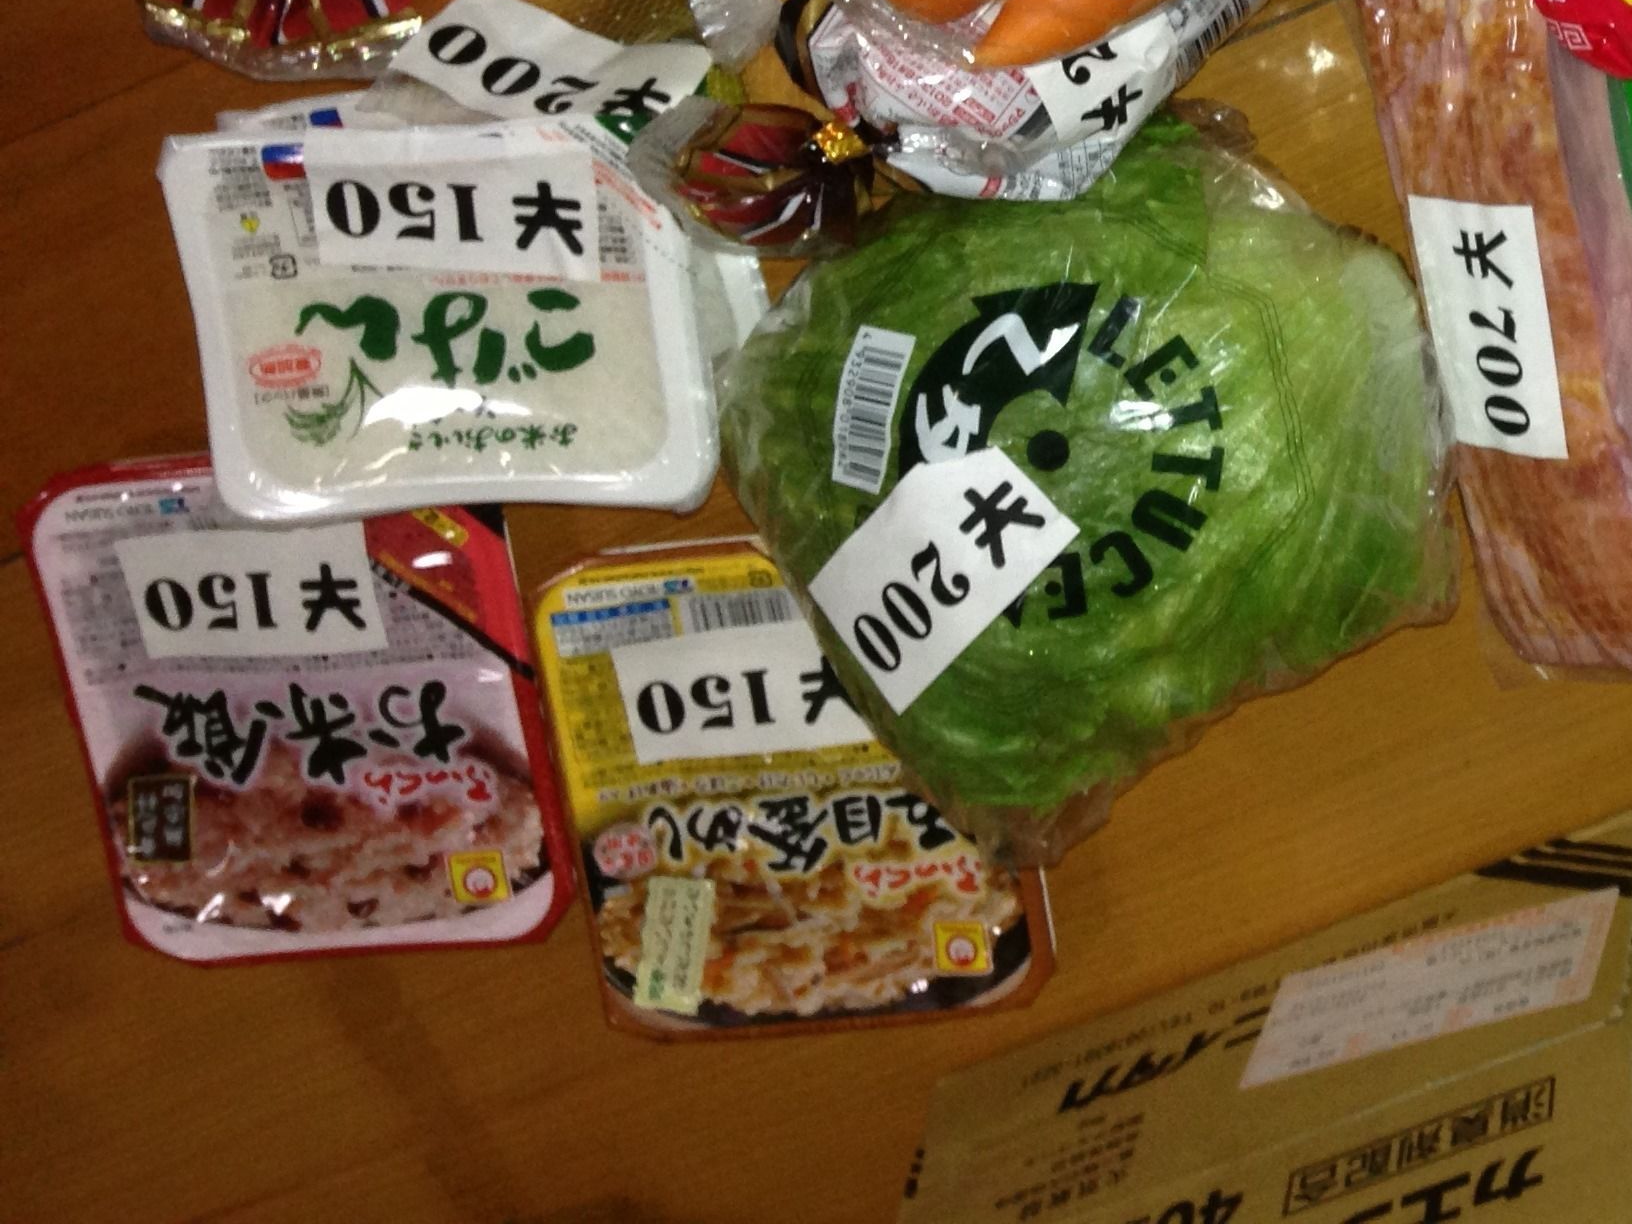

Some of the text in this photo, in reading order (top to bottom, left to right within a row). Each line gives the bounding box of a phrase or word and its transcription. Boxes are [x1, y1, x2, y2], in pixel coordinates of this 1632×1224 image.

[425, 23, 671, 120] ¥200
[1058, 39, 1142, 132] ¥2
[323, 178, 584, 256] ¥150
[294, 289, 595, 387] ごはん
[1452, 228, 1530, 436] ¥700
[142, 562, 366, 632] ¥150
[852, 479, 1046, 673] ¥200
[131, 680, 465, 784] お赤飯
[644, 793, 955, 874] 五目釜めし
